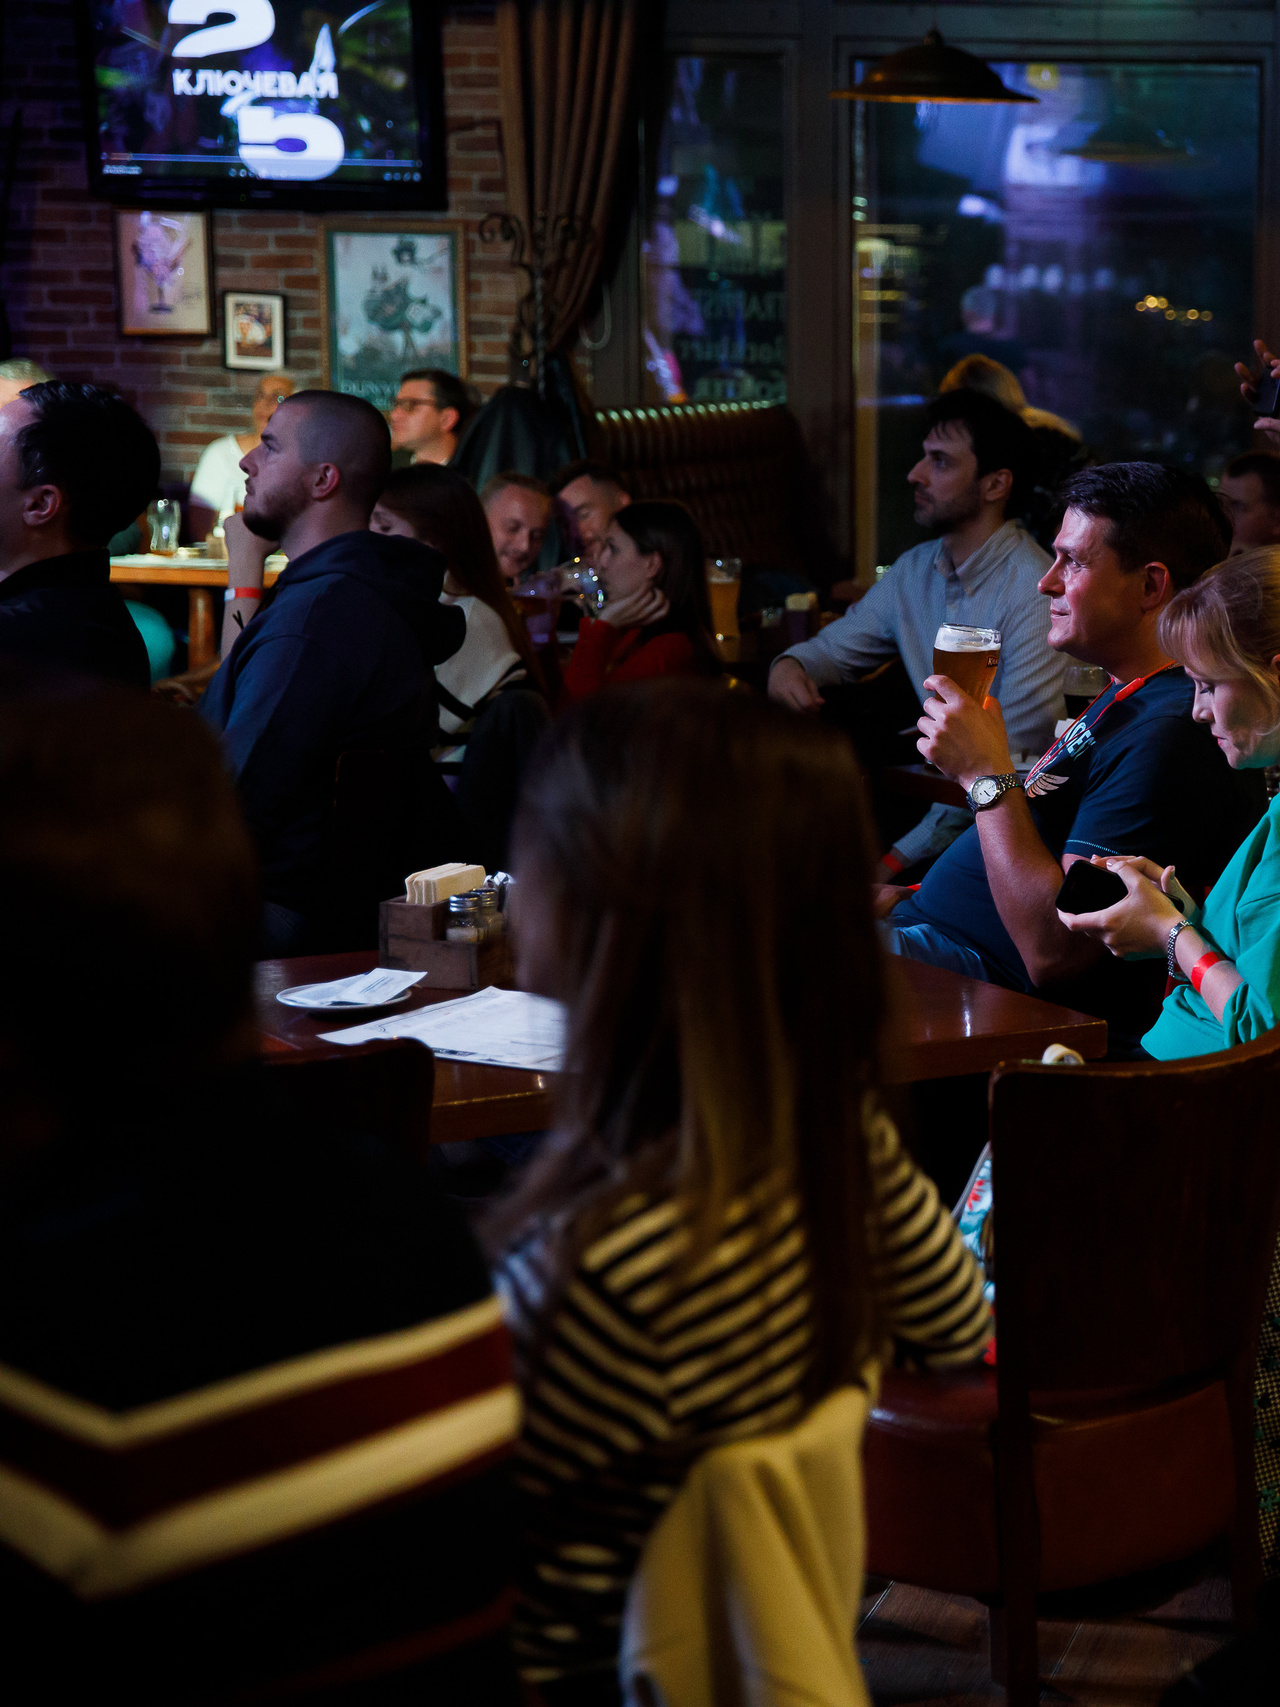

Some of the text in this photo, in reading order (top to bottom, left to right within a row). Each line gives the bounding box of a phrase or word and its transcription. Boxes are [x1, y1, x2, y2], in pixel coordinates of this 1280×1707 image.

[168, 0, 276, 58] 2
[172, 68, 339, 99] КЛЮЧЕВАЯ
[237, 105, 345, 181] 5
